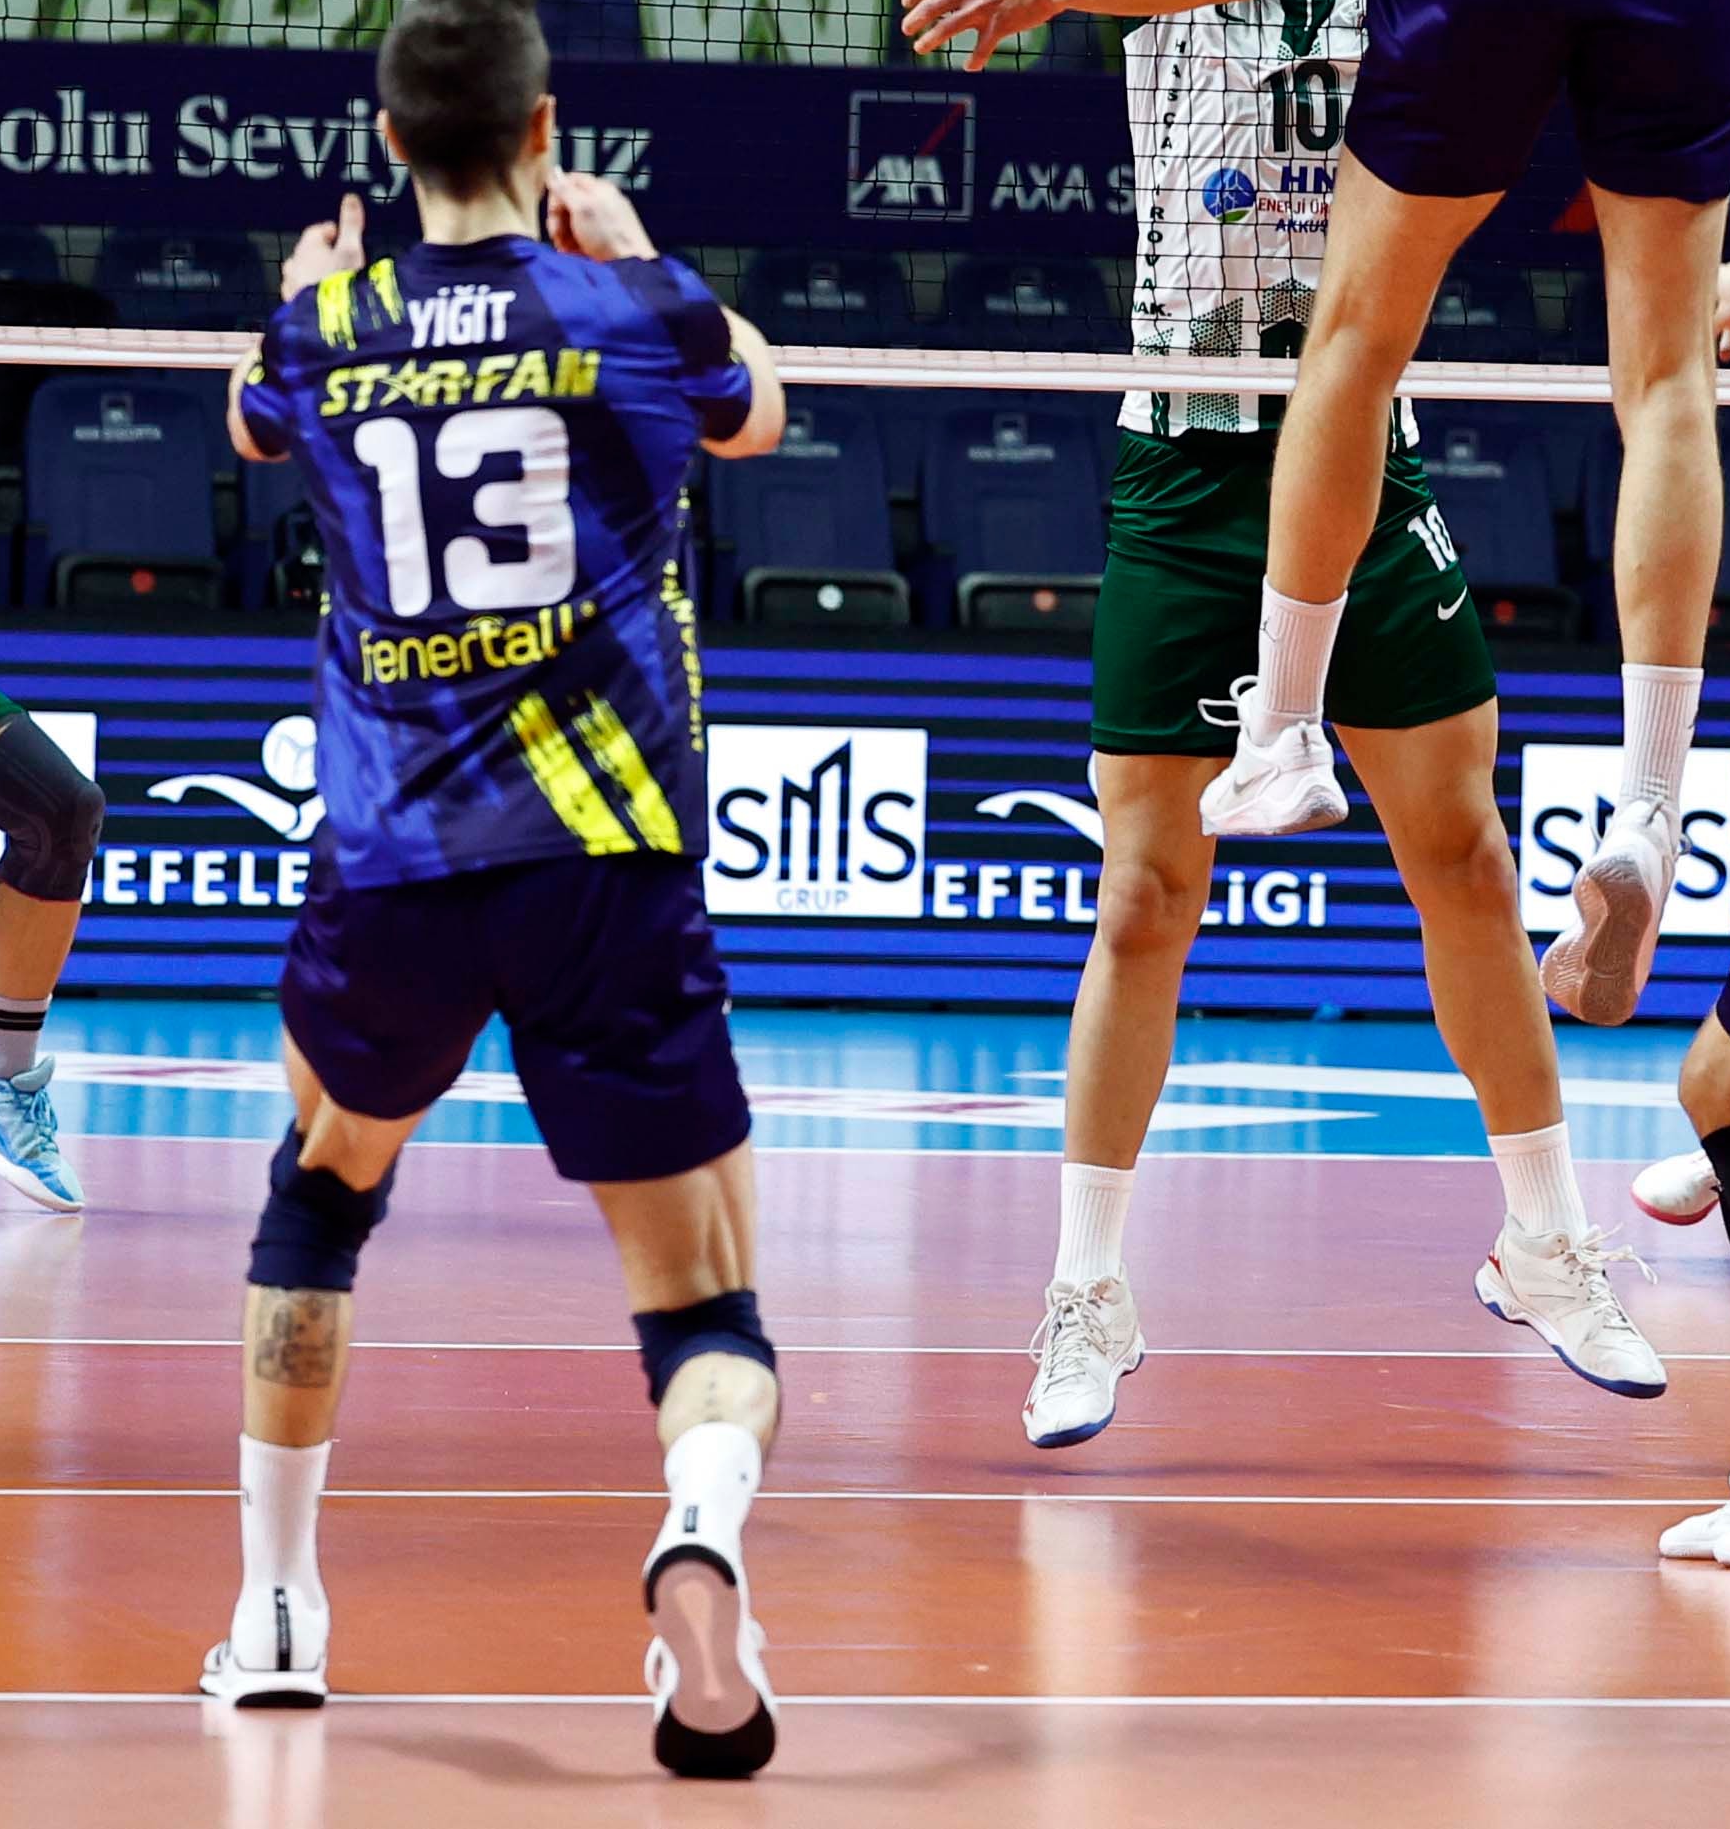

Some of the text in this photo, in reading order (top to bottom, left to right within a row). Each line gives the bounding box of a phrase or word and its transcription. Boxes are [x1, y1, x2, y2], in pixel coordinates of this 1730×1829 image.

[1253, 58, 1342, 153] 10
[851, 153, 947, 214] AXA
[989, 162, 1097, 213] AXA
[1280, 166, 1337, 194] HN
[406, 283, 516, 349] YİĞİT
[351, 405, 577, 619] 13
[1406, 503, 1459, 573] 10
[713, 738, 918, 884] SMS
[102, 848, 310, 907] EFELE
[775, 888, 850, 911] GRUP
[933, 862, 1097, 922] EFEL
